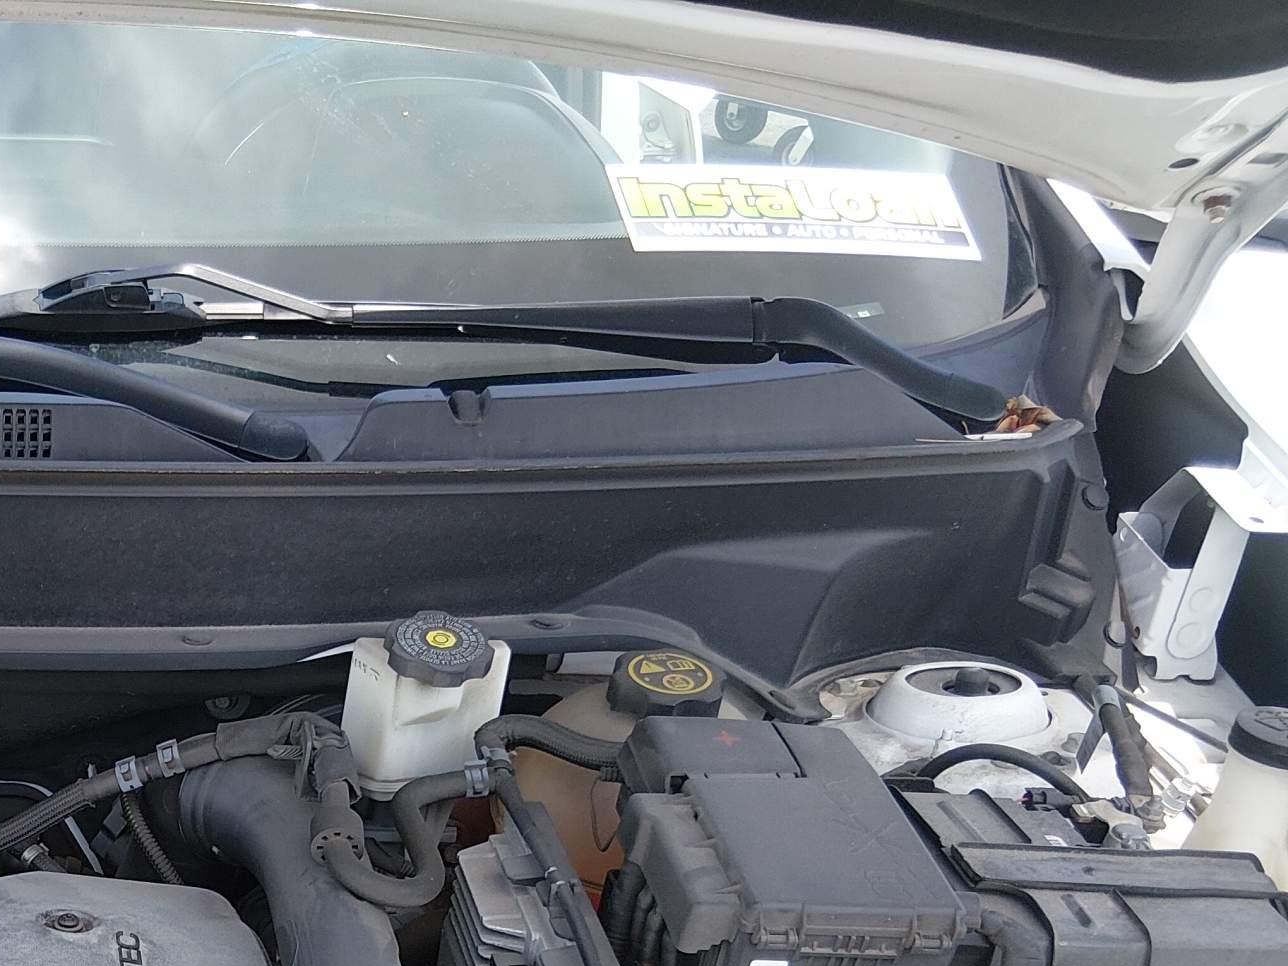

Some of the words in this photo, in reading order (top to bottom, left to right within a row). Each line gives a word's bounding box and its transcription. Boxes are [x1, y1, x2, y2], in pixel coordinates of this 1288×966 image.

[617, 176, 962, 228] InstaLoan
[787, 222, 837, 239] AUTO
[853, 226, 943, 243] PERSONAL
